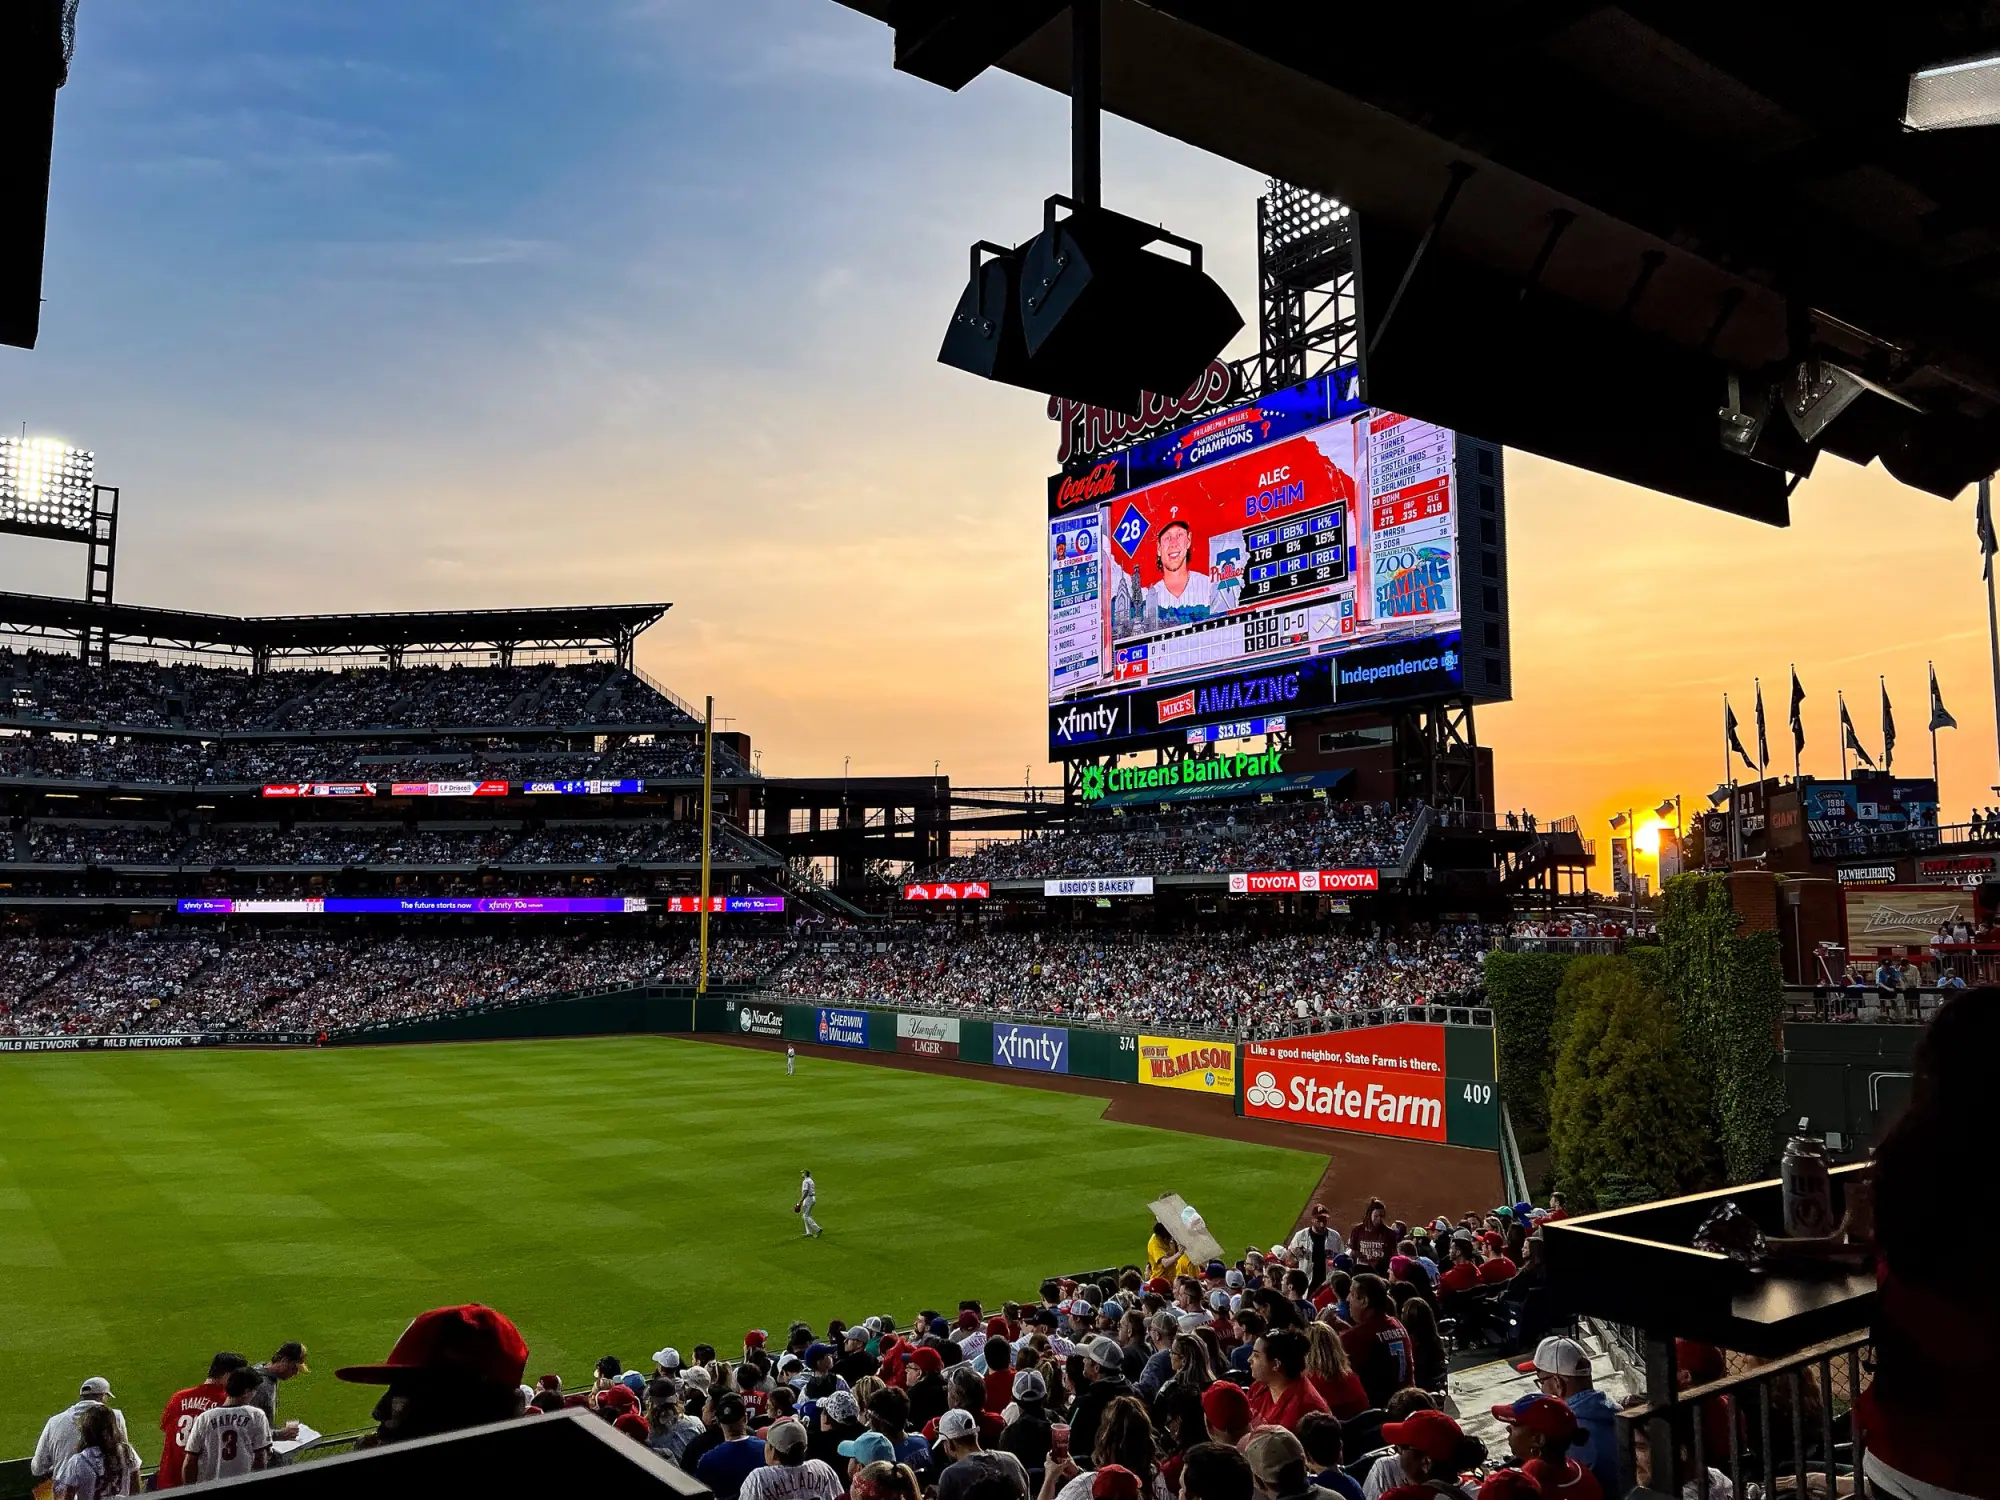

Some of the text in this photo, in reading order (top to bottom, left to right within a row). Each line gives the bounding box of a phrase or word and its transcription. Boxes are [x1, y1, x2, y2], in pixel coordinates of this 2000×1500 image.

[1193, 412, 1249, 438] PHILADELPHIA PHILLIES
[1380, 425, 1400, 440] STOTT
[1198, 424, 1246, 446] NATIONAL LEAGUE
[1381, 436, 1404, 451] TURNER
[1190, 429, 1253, 462] CHAMPIONS
[1381, 447, 1405, 461] HARPER
[1381, 450, 1426, 473] CASTELLANOS
[1258, 466, 1290, 488] ALEC
[1382, 463, 1420, 483] SCHWARBER
[1057, 460, 1118, 509] Coca-Cola
[1382, 476, 1415, 493] REALMUTO
[1246, 480, 1304, 518] BOHM
[1382, 492, 1400, 504] BOHM
[1382, 494, 1439, 516] AVG OBP SLG
[1379, 515, 1394, 527] .272
[1401, 509, 1417, 521] .335
[1121, 519, 1140, 543] 28
[1257, 516, 1331, 546] PA BB% K%
[1383, 526, 1405, 537] MARSH
[1080, 537, 1088, 546] 20
[1255, 531, 1335, 561] 176 8% 16%
[1384, 538, 1400, 549] SOSA
[1376, 546, 1415, 558] PHILADELPHIA
[1261, 550, 1335, 578] R HR RBI
[1376, 553, 1414, 574] ZOO
[1210, 564, 1245, 583] Phillies
[1258, 567, 1330, 593] 19 5 32
[1376, 558, 1451, 602] STAYING
[1344, 604, 1349, 614] 5
[1380, 584, 1446, 617] POWER
[1059, 623, 1076, 634] GOMES
[1284, 614, 1304, 631] 0-0
[1345, 620, 1349, 630] 3
[1059, 639, 1075, 650] MOREL
[1132, 620, 1275, 659] CHI 0 4 4 5 0
[1248, 640, 1252, 650] 1
[1259, 638, 1264, 648] 2
[1271, 636, 1276, 645] 0
[1342, 657, 1438, 684] Independence
[1163, 673, 1299, 717] MIKE'S AMAZING
[1057, 703, 1118, 740] xfinity
[1218, 723, 1251, 739] $13,765
[1108, 746, 1283, 792] Citizens Bank Park
[449, 783, 471, 791] Driscoll
[531, 783, 555, 791] GOYA
[1827, 799, 1845, 807] 1980
[1773, 810, 1797, 828] GIANT
[1827, 808, 1845, 816] 2008
[1059, 879, 1134, 894] LISCIO'S BAKERY
[1251, 876, 1296, 889] TOYOTA
[1323, 874, 1374, 887] TOYOTA
[184, 902, 203, 910] xfinity
[401, 901, 413, 909] The
[414, 901, 435, 909] future
[488, 901, 512, 910] xfinity
[732, 901, 751, 909] xfinity
[1871, 911, 1949, 926] Budweiser
[752, 1010, 783, 1027] NovaCare
[830, 1011, 863, 1029] SHERWIN
[908, 1017, 947, 1039] Yuengling
[0, 1039, 79, 1050] MLB NETWORK
[103, 1037, 182, 1047] MLB NETWORK
[915, 1040, 941, 1054] LAGER
[998, 1027, 1063, 1070] xfinity
[1119, 1036, 1134, 1051] 374
[1142, 1047, 1168, 1057] WHO BUT
[1250, 1044, 1441, 1072] Like a good neighbor, State Farm is there.
[1205, 1073, 1215, 1086] hp
[1463, 1083, 1491, 1105] 409
[1376, 1329, 1404, 1342] TURNE
[181, 1396, 217, 1411] HAMELS
[210, 1413, 250, 1430] HARPER
[222, 1430, 238, 1461] 3
[762, 1468, 829, 1499] HALLADAY
